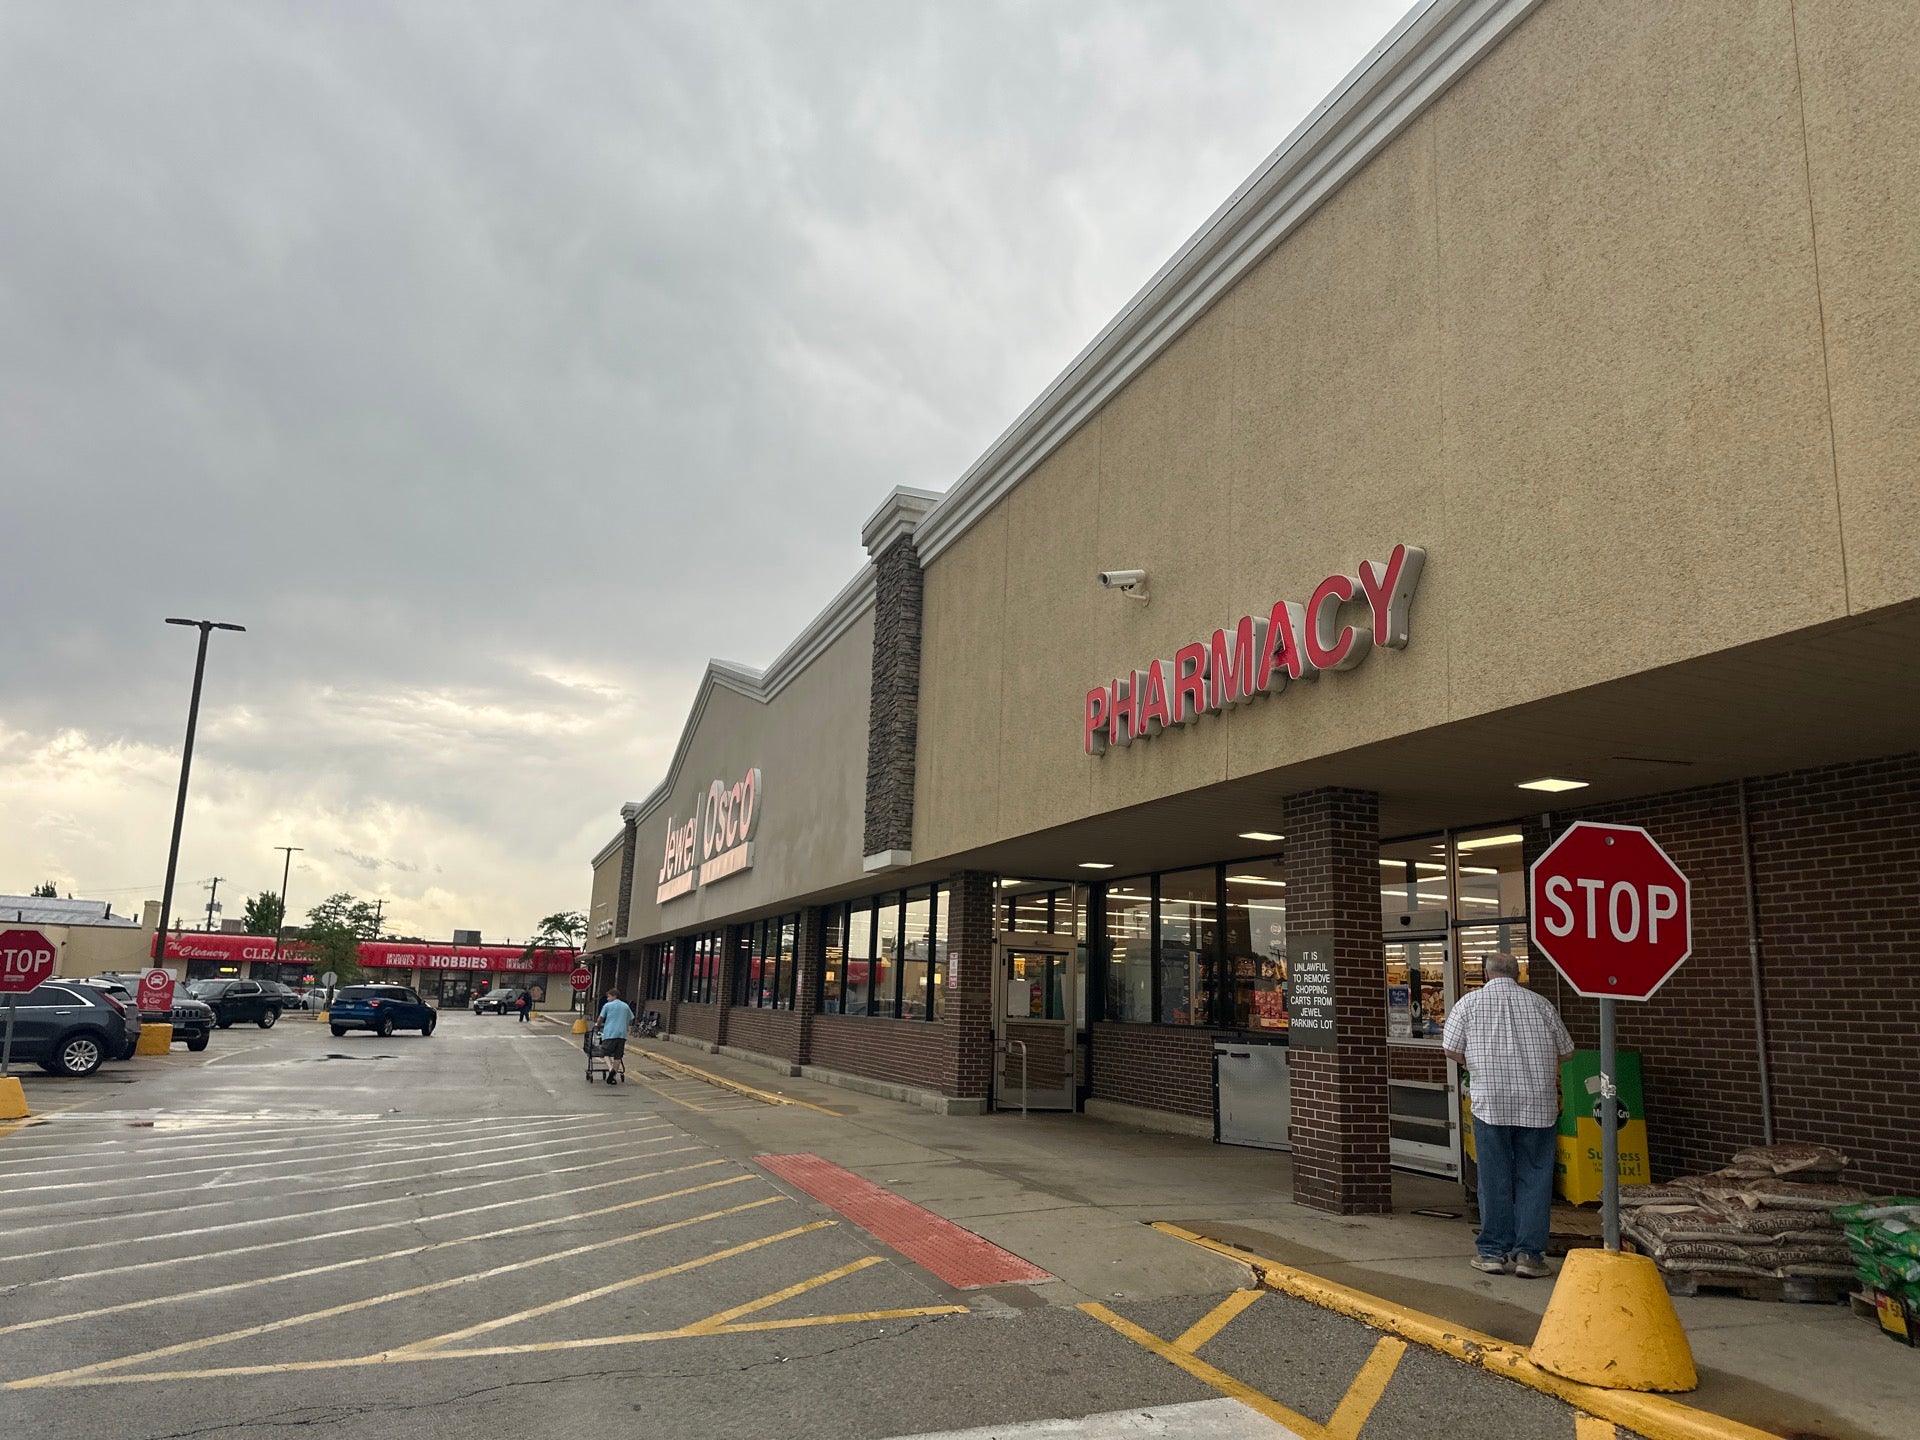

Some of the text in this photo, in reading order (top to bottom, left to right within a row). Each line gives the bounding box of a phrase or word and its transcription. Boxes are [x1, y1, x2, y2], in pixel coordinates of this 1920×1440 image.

[1085, 543, 1424, 756] PHARMACY
[659, 768, 762, 884] Jewel Osco
[1544, 876, 1679, 944] STOP
[167, 942, 230, 959] The Cleanery
[0, 949, 51, 973] TOP
[1303, 952, 1319, 961] IT IS
[430, 955, 488, 969] HOBBIES
[1295, 963, 1328, 972] UNLAWFUL
[571, 974, 591, 985] STOP
[1293, 974, 1331, 983] TO REMOVE
[1296, 985, 1328, 995] SHOPPING
[1291, 996, 1333, 1006] CARTS FROM
[1301, 1008, 1323, 1017] JEWEL
[1291, 1019, 1319, 1029] PARKING
[1321, 1020, 1334, 1029] LOT
